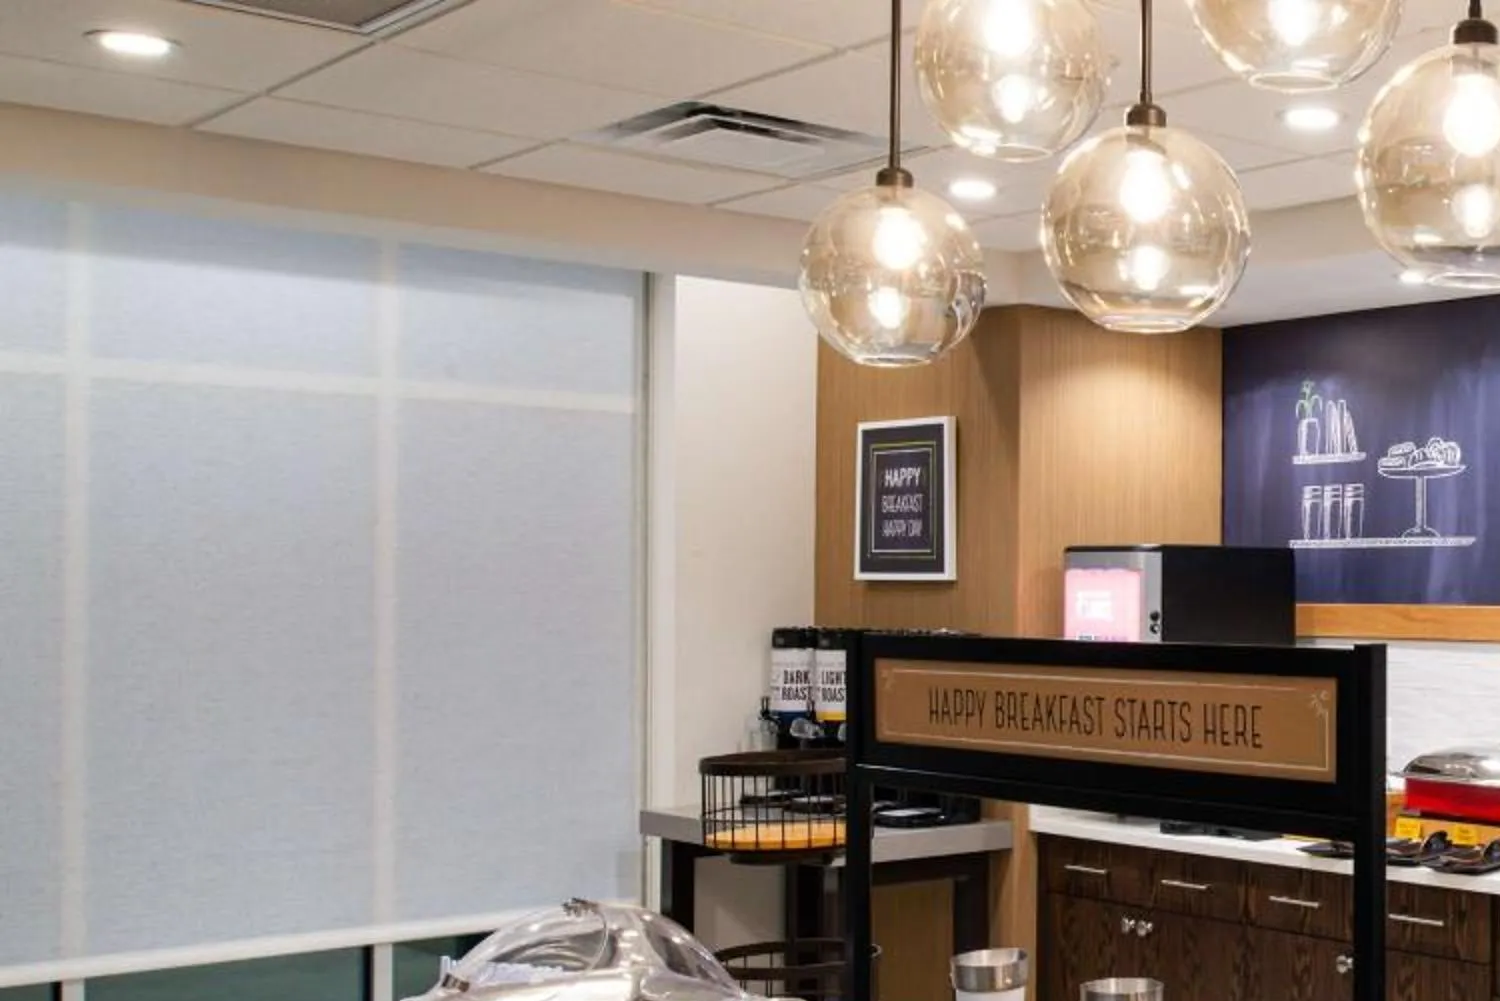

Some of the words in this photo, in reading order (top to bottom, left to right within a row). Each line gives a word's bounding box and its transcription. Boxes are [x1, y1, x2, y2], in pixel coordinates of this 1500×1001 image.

[884, 467, 922, 488] HAPPY
[783, 669, 812, 685] DARK
[928, 687, 987, 730] HAPPY
[994, 691, 1105, 736] BREAKFAST
[1114, 698, 1193, 744] STARTS
[1203, 703, 1264, 750] HERE
